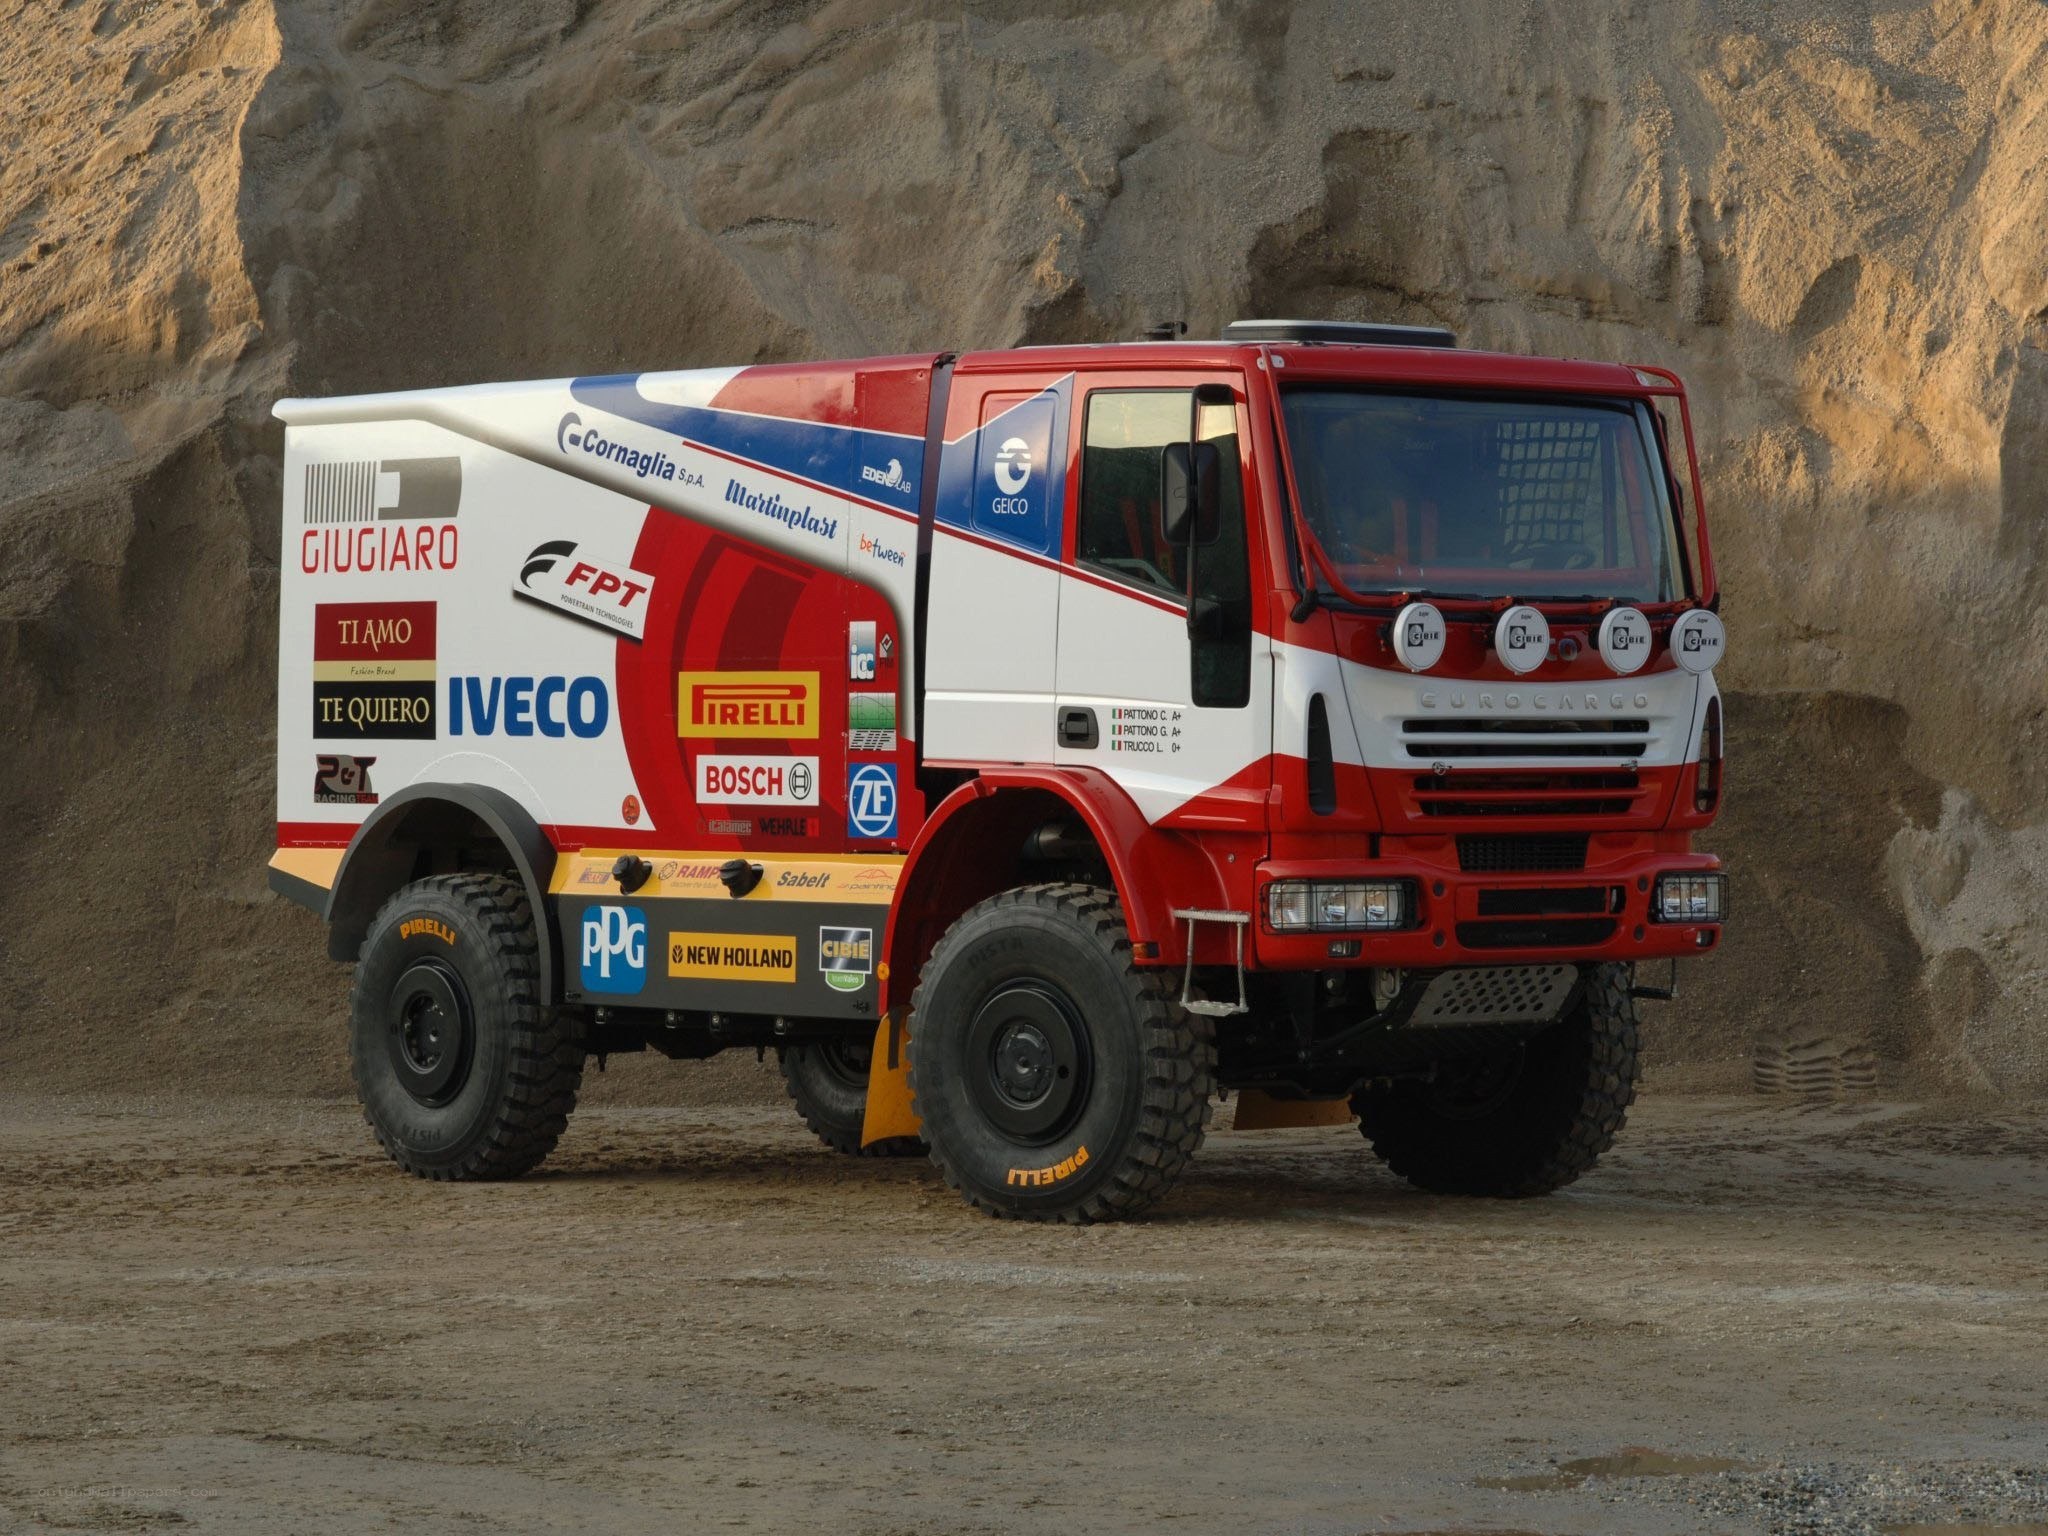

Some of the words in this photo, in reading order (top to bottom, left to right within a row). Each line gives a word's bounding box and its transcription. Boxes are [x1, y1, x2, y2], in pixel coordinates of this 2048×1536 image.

[583, 429, 675, 481] Cornaglia
[679, 468, 705, 488] S.p.A.
[725, 478, 838, 539] Martinplast
[992, 497, 1028, 515] GEICO
[302, 524, 459, 573] GIUGIARO
[860, 533, 904, 568] between
[565, 561, 647, 608] FPT
[561, 594, 594, 613] POWERTRAIN
[595, 607, 634, 629] TECHNOLOGIES
[338, 619, 359, 644] TI
[362, 618, 412, 653] AMO
[350, 666, 375, 676] Fashion
[376, 666, 396, 676] Brand
[319, 697, 343, 722] TE
[347, 697, 430, 731] QUIERO
[449, 676, 609, 739] IVECO
[691, 684, 807, 726] PIRELLI
[1123, 708, 1158, 720] PATTONO
[1160, 710, 1167, 720] C.
[1171, 710, 1181, 721] A+
[1420, 692, 1649, 710] EUROCARGO
[1123, 724, 1158, 736] PATTONO
[1160, 726, 1168, 736] G.
[1171, 726, 1181, 737] A+
[1123, 740, 1155, 752] TRUCCO
[1156, 742, 1164, 753] L.
[706, 765, 783, 796] BOSCH
[314, 793, 356, 803] RACING
[854, 780, 891, 821] ZF
[760, 817, 806, 836] WEHRLE
[676, 864, 721, 880] RAMP
[777, 870, 831, 889] Sabelt
[400, 918, 456, 945] PIRELLI
[687, 945, 721, 965] NEW
[723, 947, 793, 969] HOLLAND
[1007, 1145, 1090, 1187] PIRELLI
